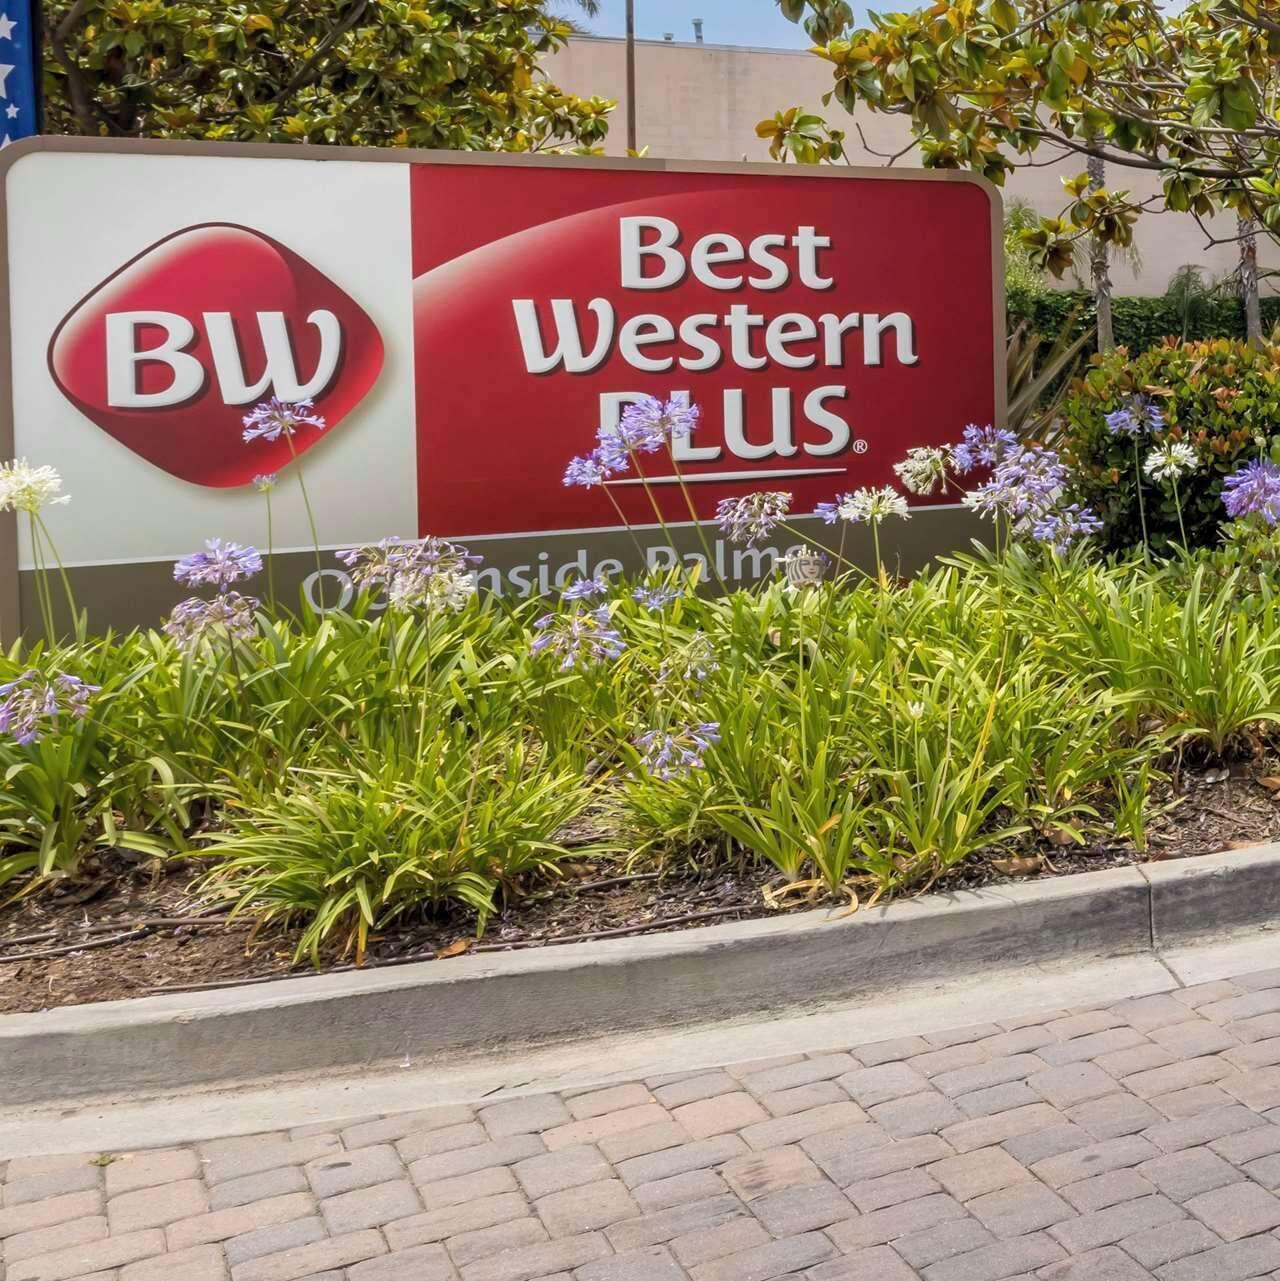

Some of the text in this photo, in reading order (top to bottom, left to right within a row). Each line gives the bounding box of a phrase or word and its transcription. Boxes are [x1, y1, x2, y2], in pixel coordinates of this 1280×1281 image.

[619, 215, 833, 290] Best
[105, 309, 341, 408] BW
[511, 297, 919, 374] Western
[303, 548, 625, 615] Onside
